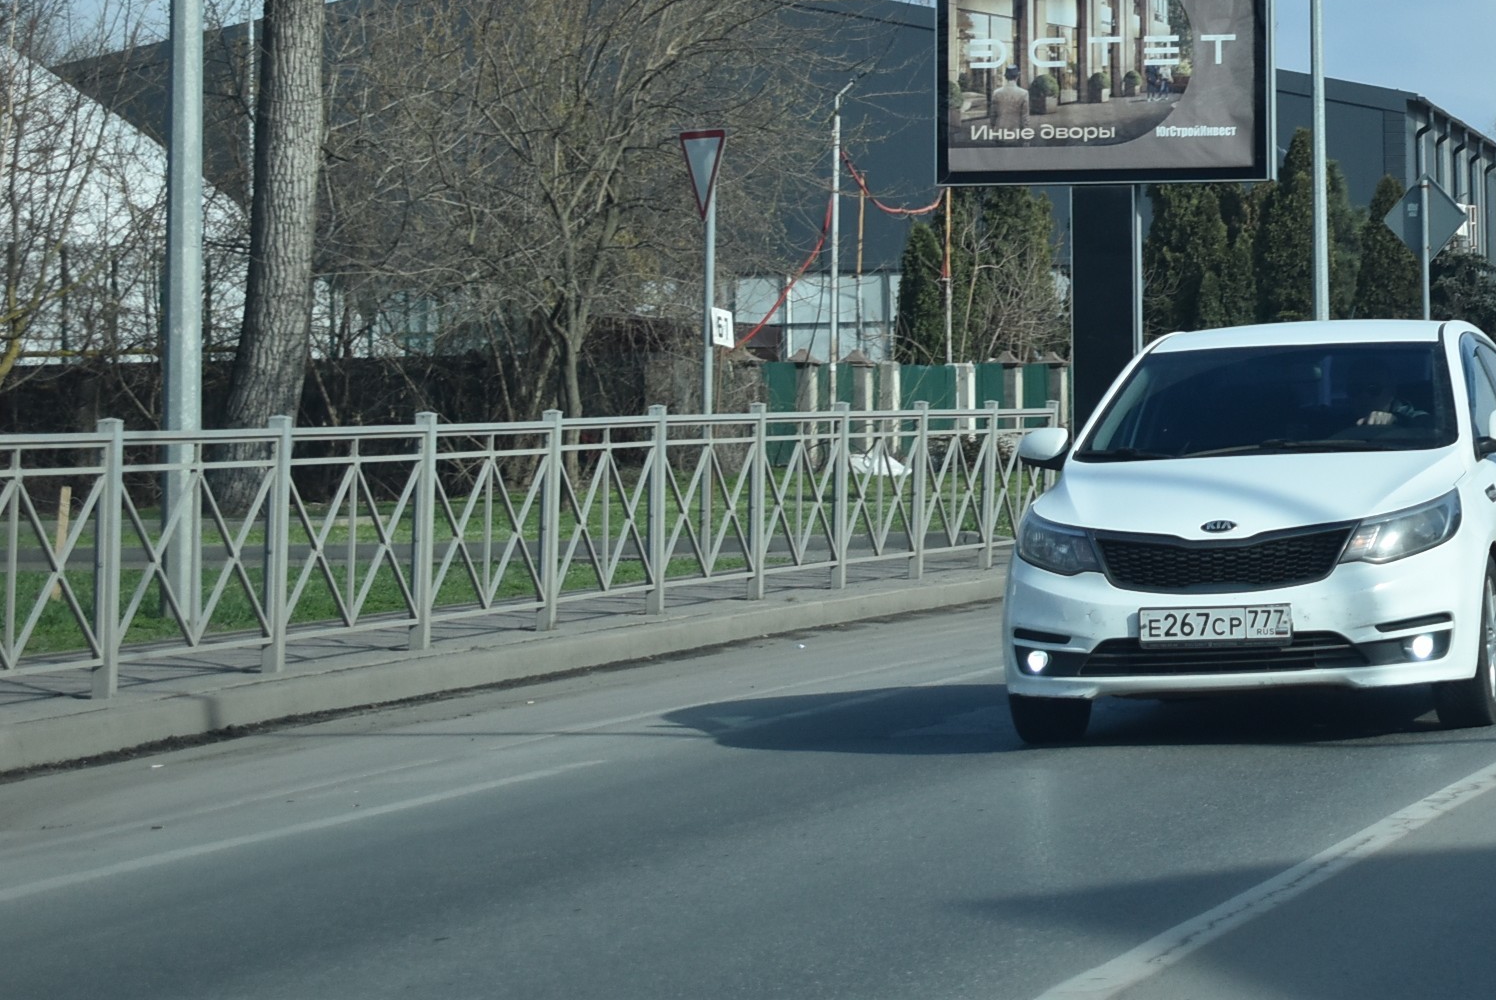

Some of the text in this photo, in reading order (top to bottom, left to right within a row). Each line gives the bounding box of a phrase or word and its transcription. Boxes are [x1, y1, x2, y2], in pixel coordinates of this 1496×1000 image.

[970, 34, 1236, 69] ЭСТЕТ
[970, 124, 1116, 142] Иные дворы
[1156, 125, 1237, 138] ЮгСтройИнвест
[1206, 520, 1232, 530] KIA
[1256, 627, 1275, 636] RUS
